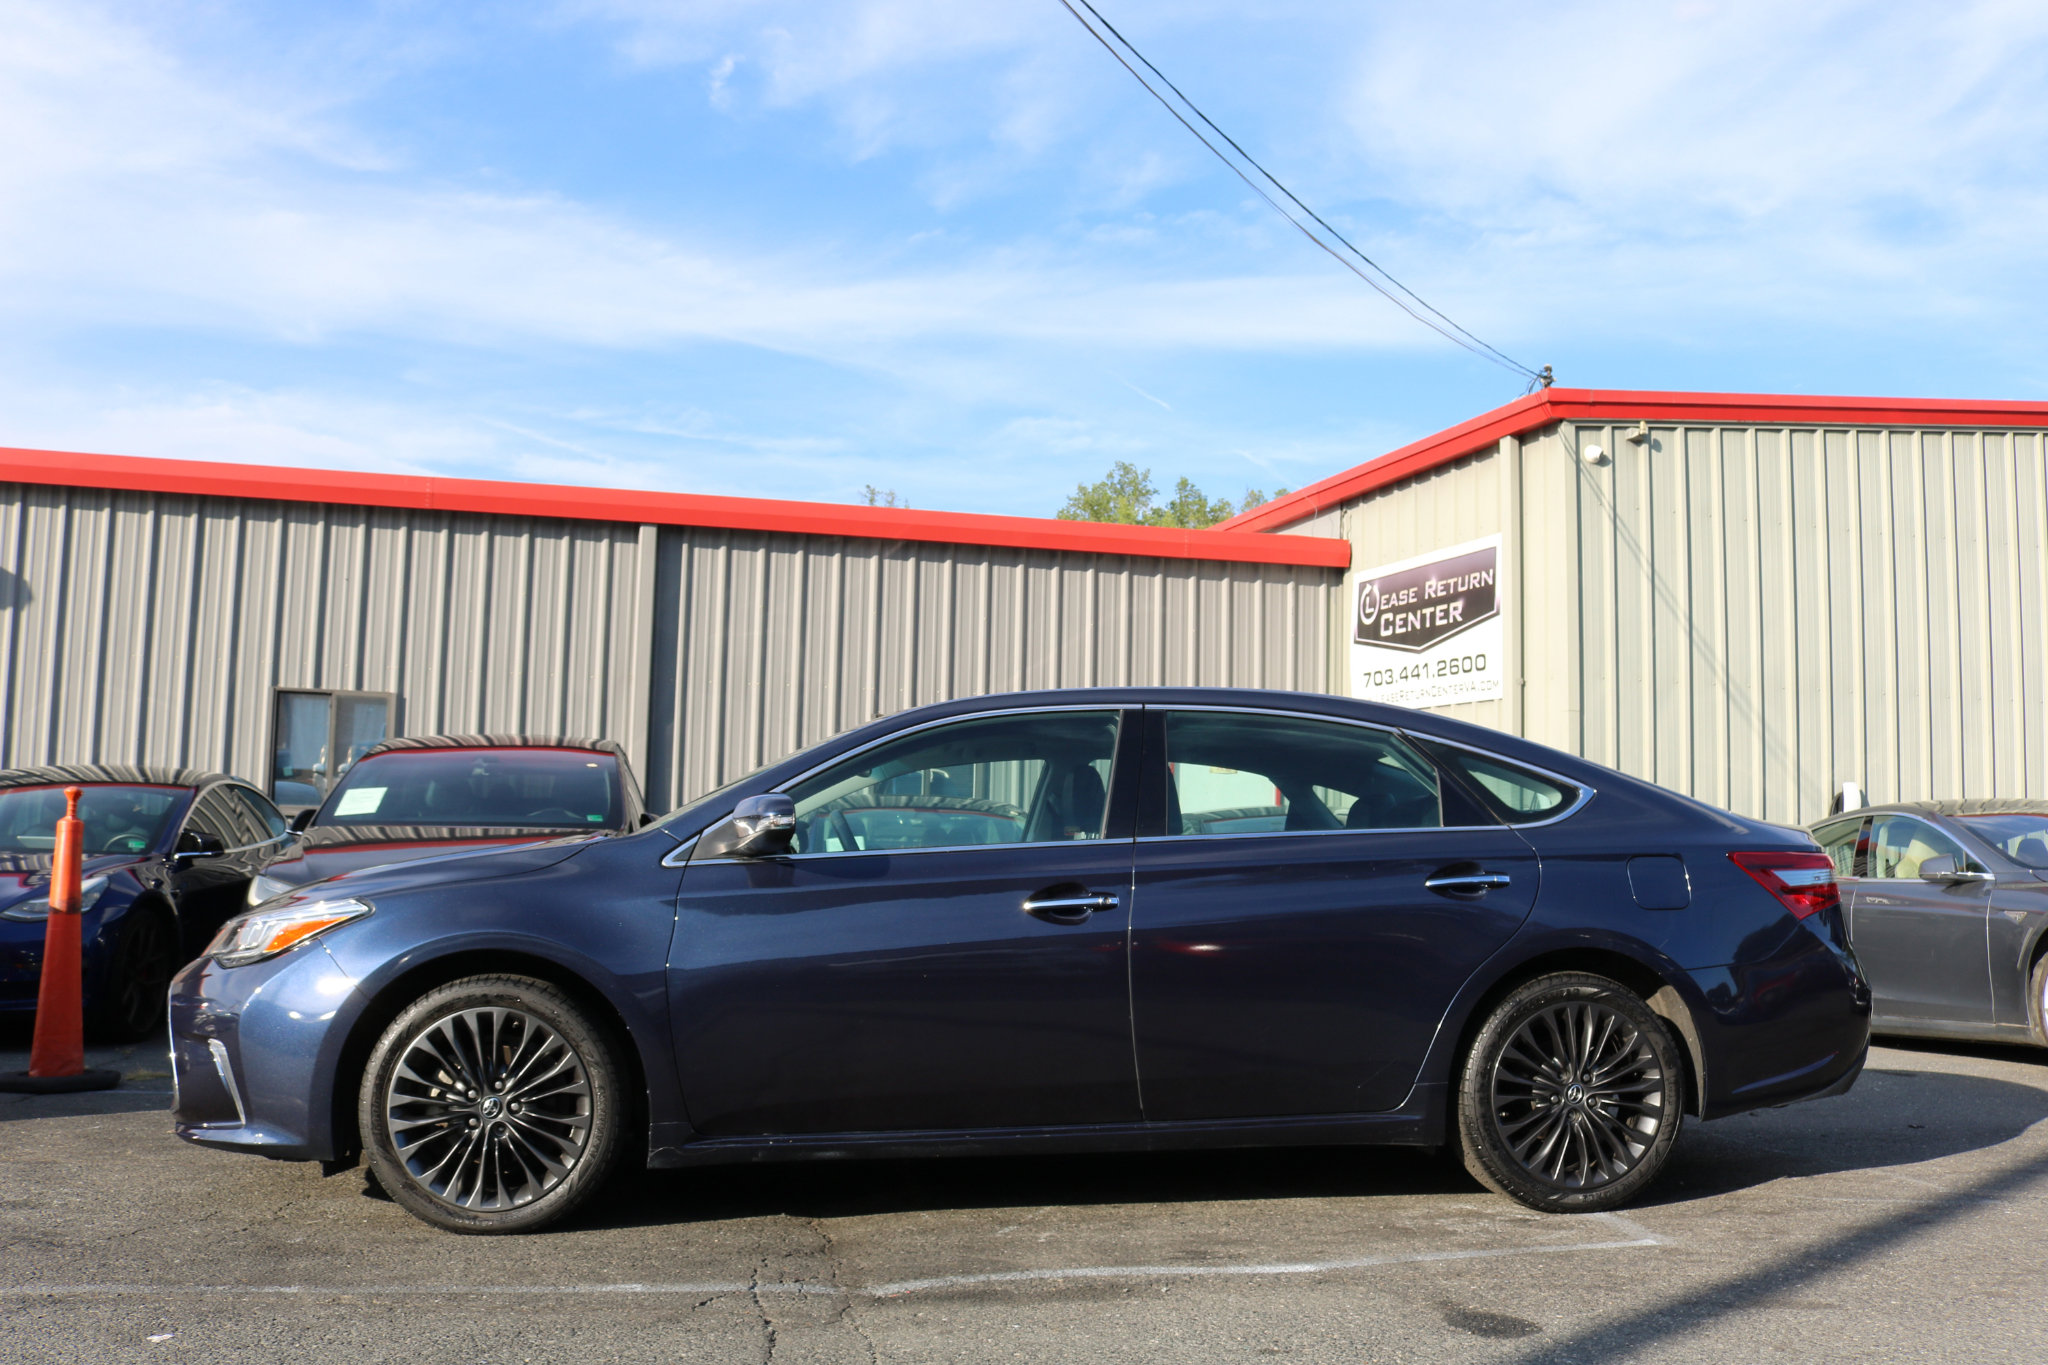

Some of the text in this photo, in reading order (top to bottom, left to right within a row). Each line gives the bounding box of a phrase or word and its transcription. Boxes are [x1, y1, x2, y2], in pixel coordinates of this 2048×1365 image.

[1424, 568, 1494, 600] RETURN
[1379, 600, 1463, 637] CENTER
[1363, 653, 1487, 688] 703.441.2600
